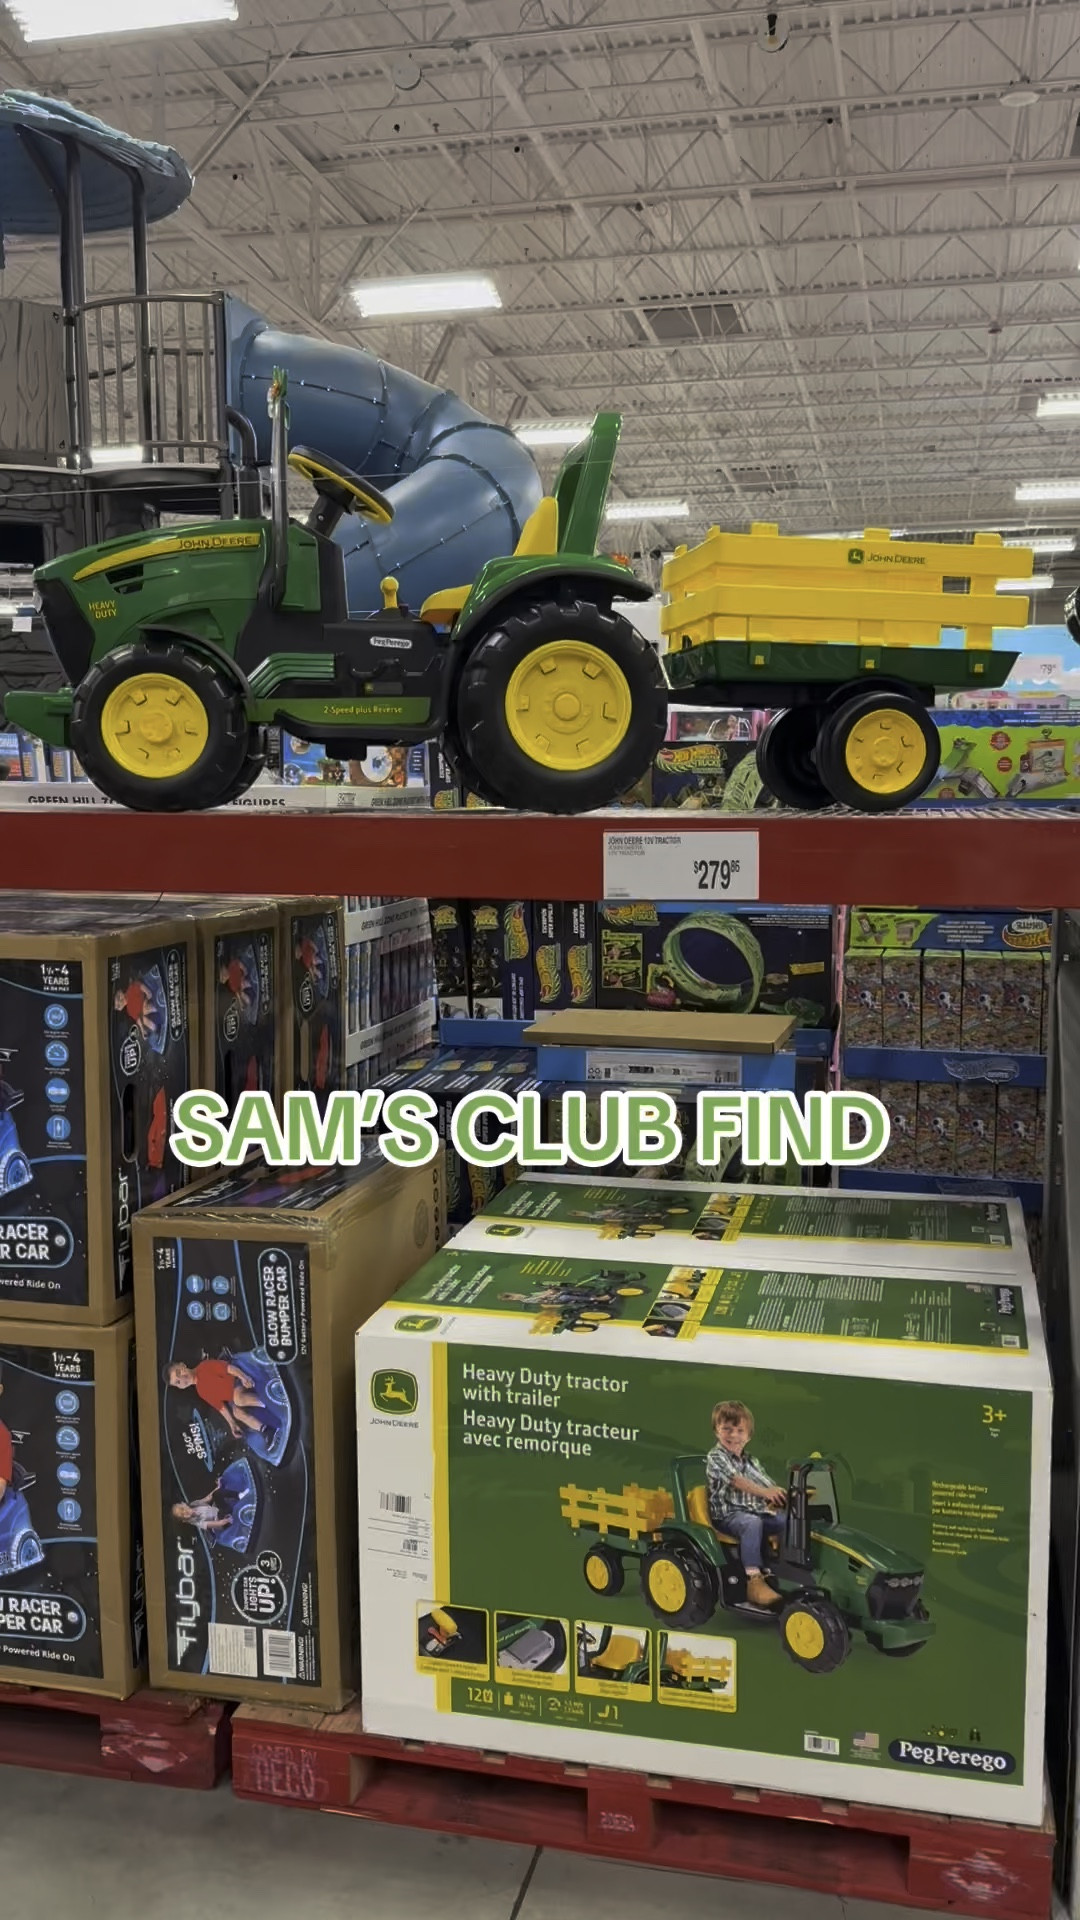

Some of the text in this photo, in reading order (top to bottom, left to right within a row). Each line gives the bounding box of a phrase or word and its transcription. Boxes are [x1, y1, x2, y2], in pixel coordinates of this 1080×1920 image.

[179, 535, 252, 549] JOHN DEERE
[867, 554, 926, 565] JOHN DEERE
[88, 600, 116, 611] HEAVY
[95, 608, 117, 619] DUTY
[323, 705, 403, 715] 2-Speed plus Reverse
[608, 836, 623, 845] JOHN
[42, 976, 70, 985] YEARS
[15, 1243, 50, 1260] CAR
[26, 1280, 46, 1288] Ride
[48, 1281, 61, 1290] On
[263, 1266, 279, 1346] GLOW RACER
[276, 1266, 292, 1346] BUMPER CAR
[54, 1363, 81, 1373] YEARS
[463, 1363, 629, 1393] Heavy Duty tractor
[463, 1385, 561, 1408] with trailer
[982, 1404, 1007, 1424] 3+
[370, 1418, 419, 1429] JOHN DEERE
[463, 1409, 640, 1442] Heavy Duty tracteur
[182, 1432, 195, 1455] 360°
[189, 1423, 207, 1459] SPINS!
[463, 1431, 592, 1459] avec remorque
[260, 1560, 270, 1568] 3
[176, 1540, 200, 1656] flybar
[249, 1577, 258, 1612] LIGHTS
[258, 1577, 276, 1613] UP!
[8, 1597, 62, 1616] RACER
[30, 1616, 64, 1634] CAR
[3, 1645, 76, 1662] Powered Ride On
[899, 1741, 1006, 1772] PegPerego
